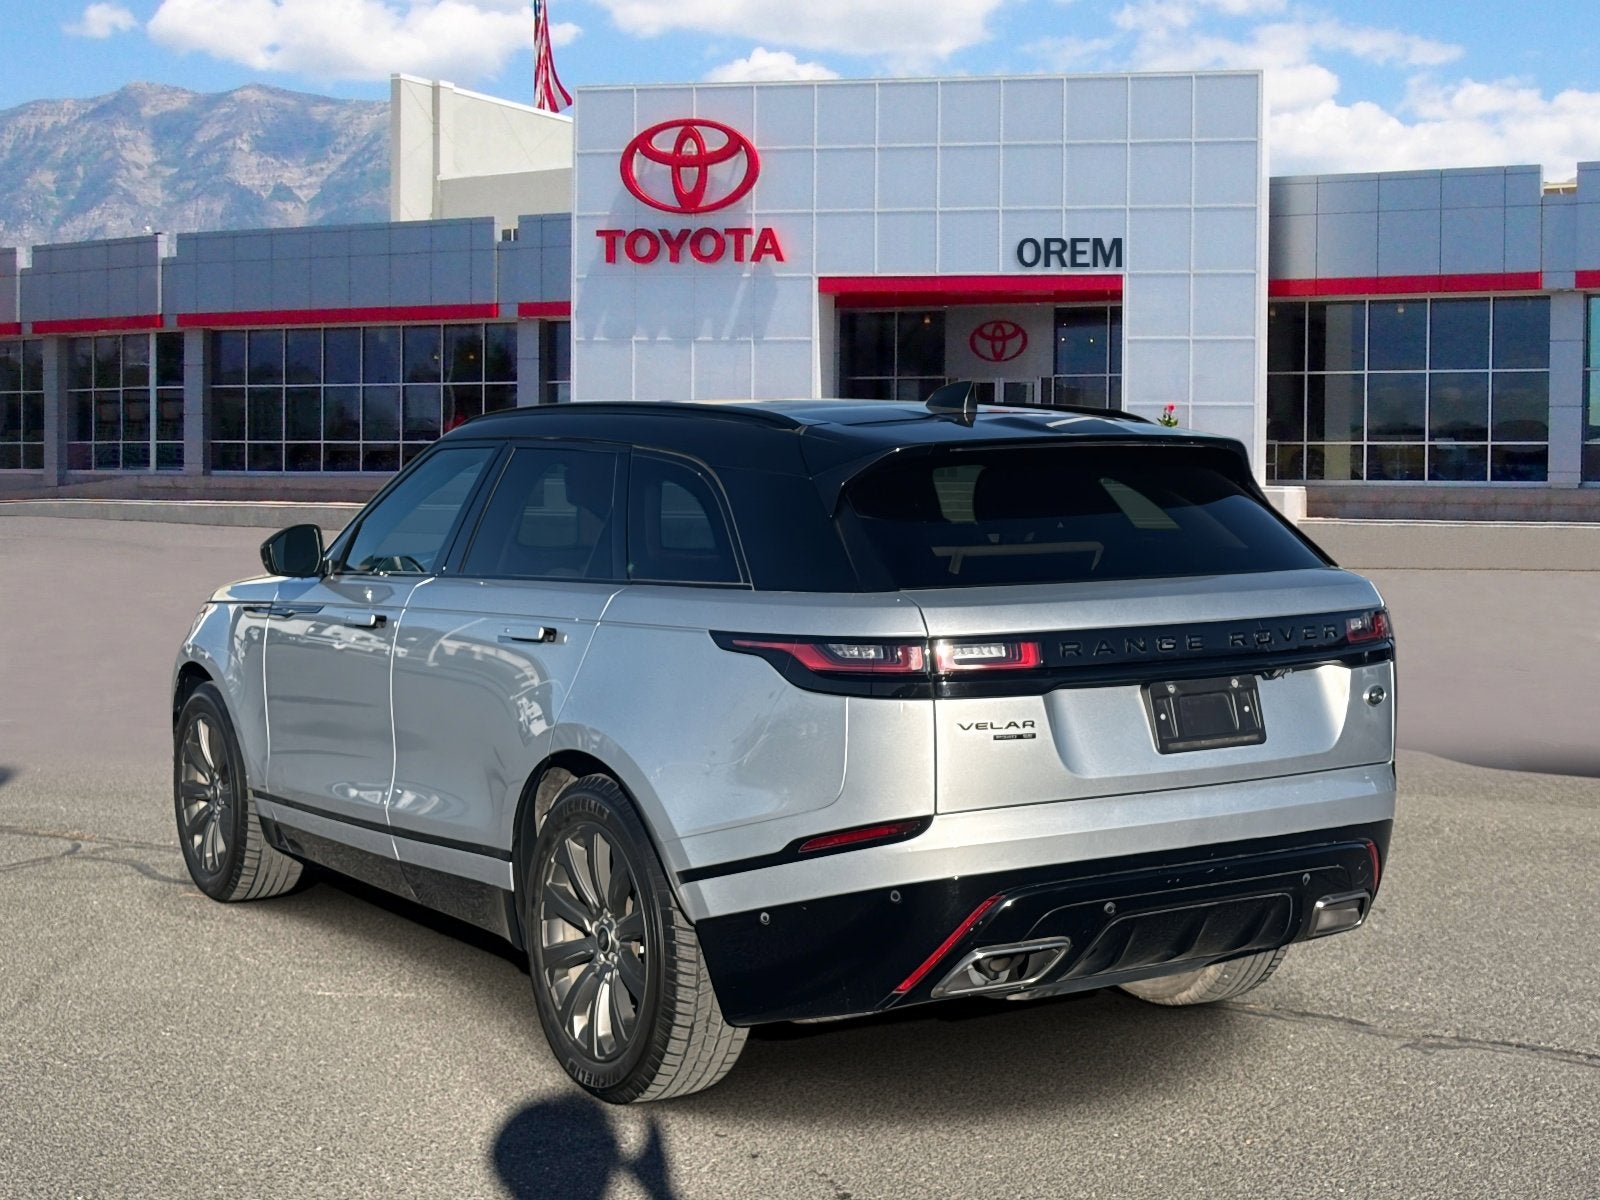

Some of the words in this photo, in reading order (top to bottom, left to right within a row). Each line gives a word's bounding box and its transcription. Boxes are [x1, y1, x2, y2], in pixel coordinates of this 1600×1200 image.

[596, 227, 786, 264] TOYOTA
[1016, 238, 1123, 268] OREM
[1060, 634, 1204, 658] RANGE
[1229, 624, 1339, 648] ROVER
[957, 720, 1036, 731] VELAR
